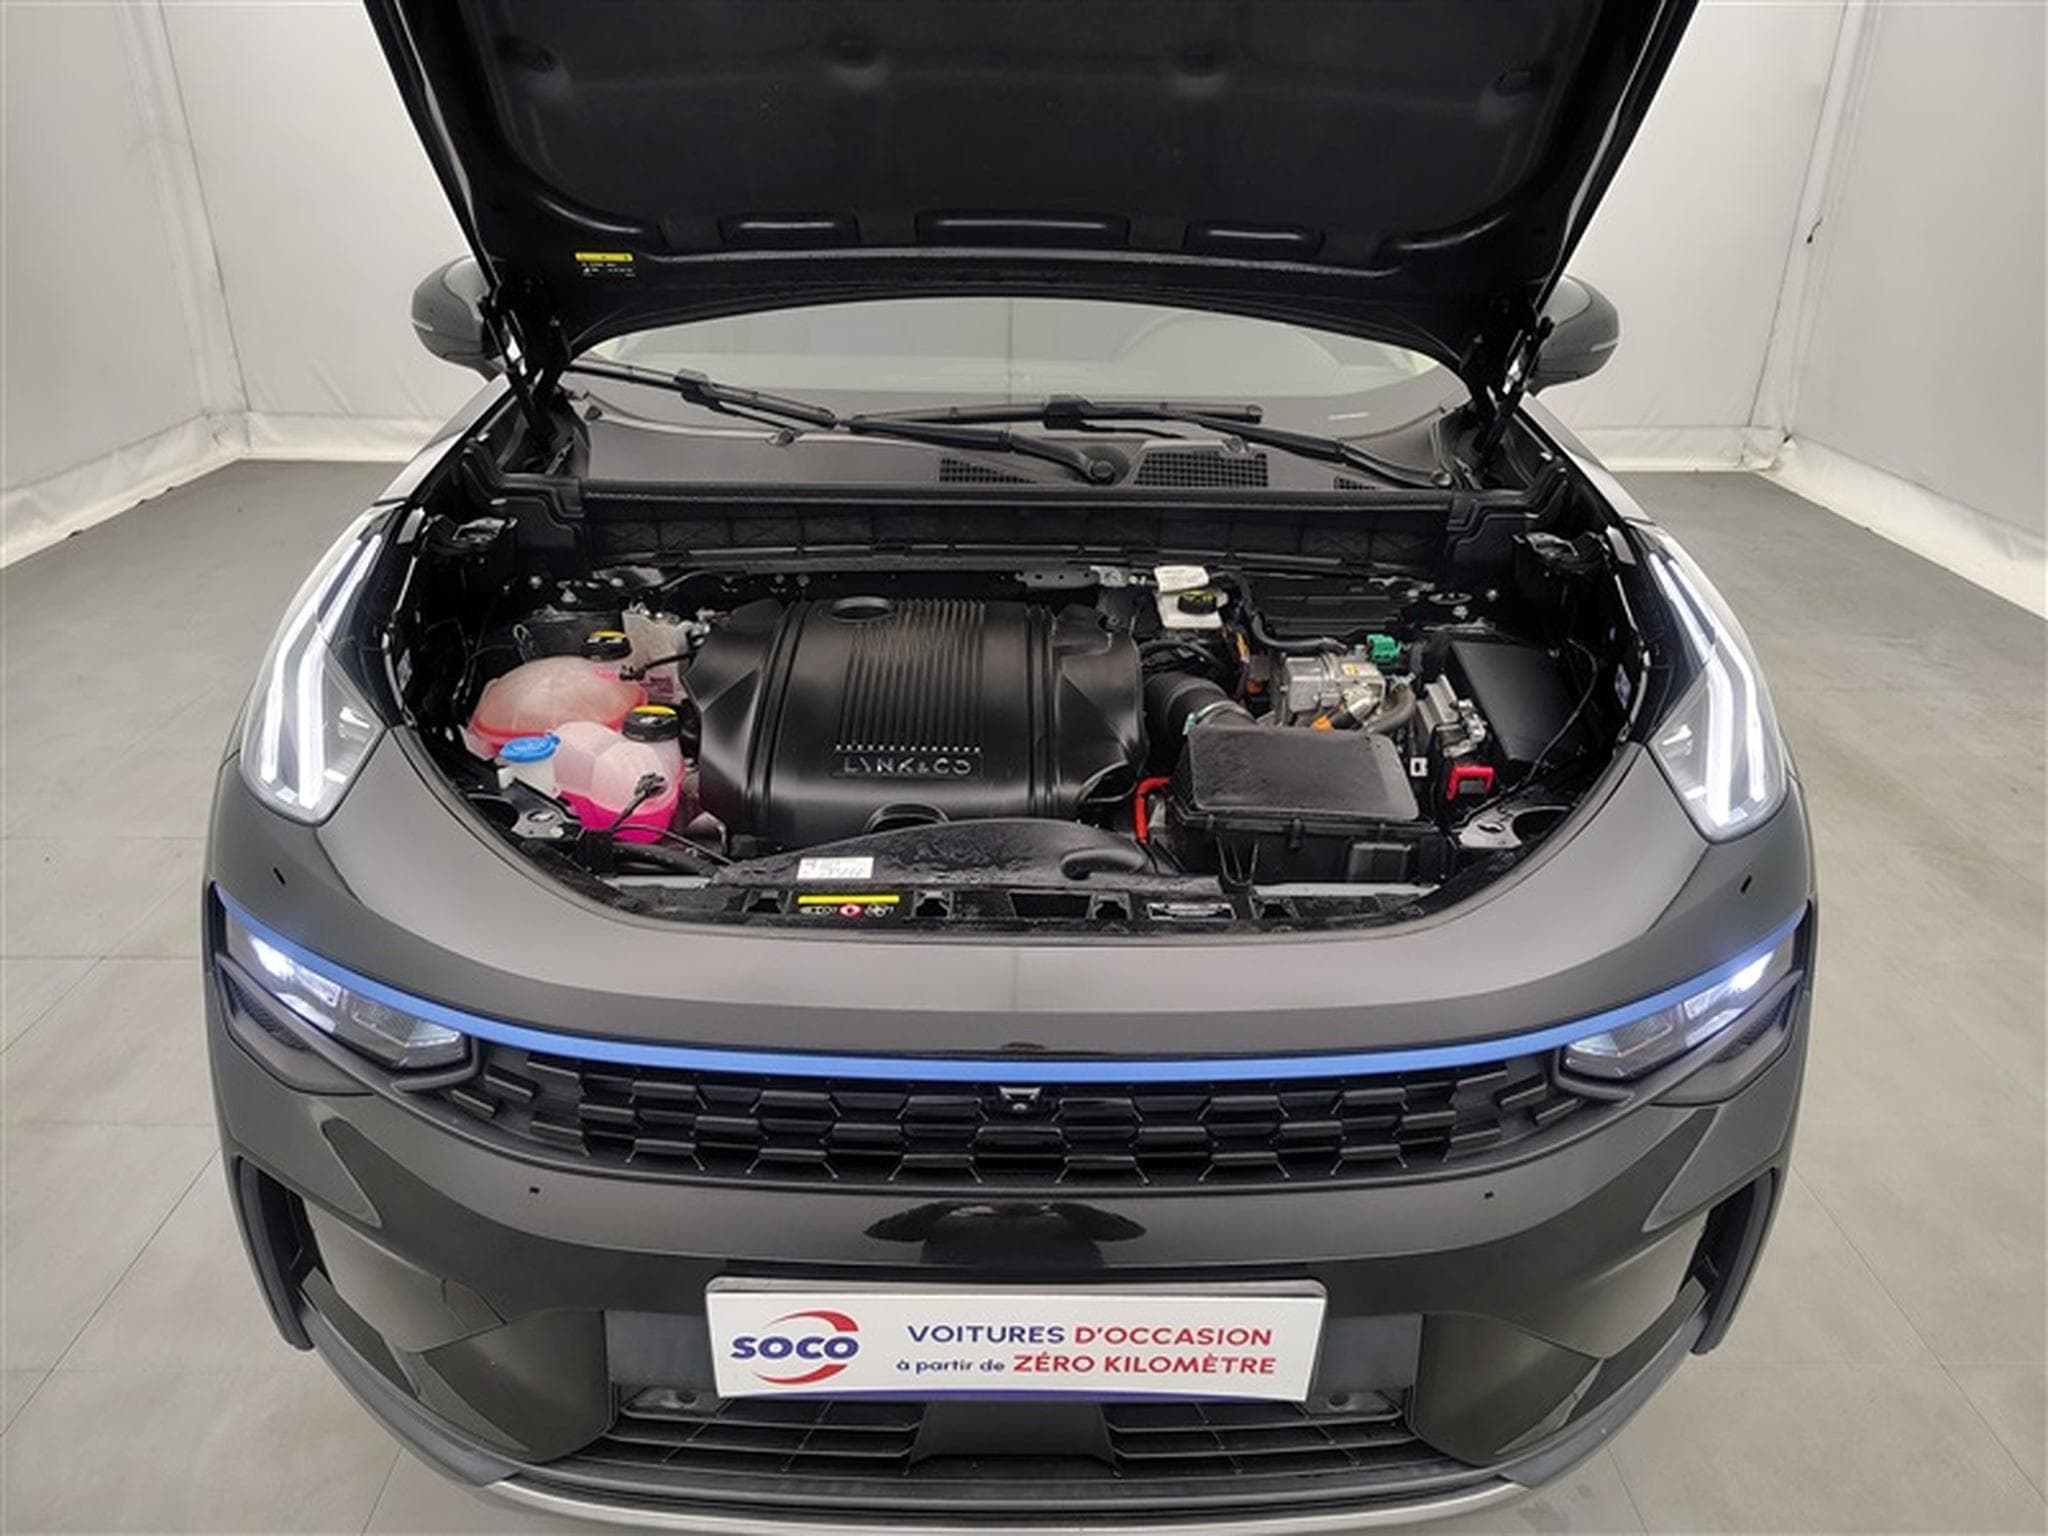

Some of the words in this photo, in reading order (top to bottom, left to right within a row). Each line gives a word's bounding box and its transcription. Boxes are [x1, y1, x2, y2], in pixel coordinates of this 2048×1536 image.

[907, 1325, 1066, 1343] VOITURES
[1074, 1326, 1273, 1346] D'OCCASION
[730, 1336, 860, 1360] SOCO
[896, 1357, 910, 1372] à
[915, 1358, 974, 1375] partir
[979, 1358, 1006, 1373] de
[1013, 1352, 1095, 1373] ZÉRO
[1104, 1352, 1276, 1374] KILOMÈTRE
